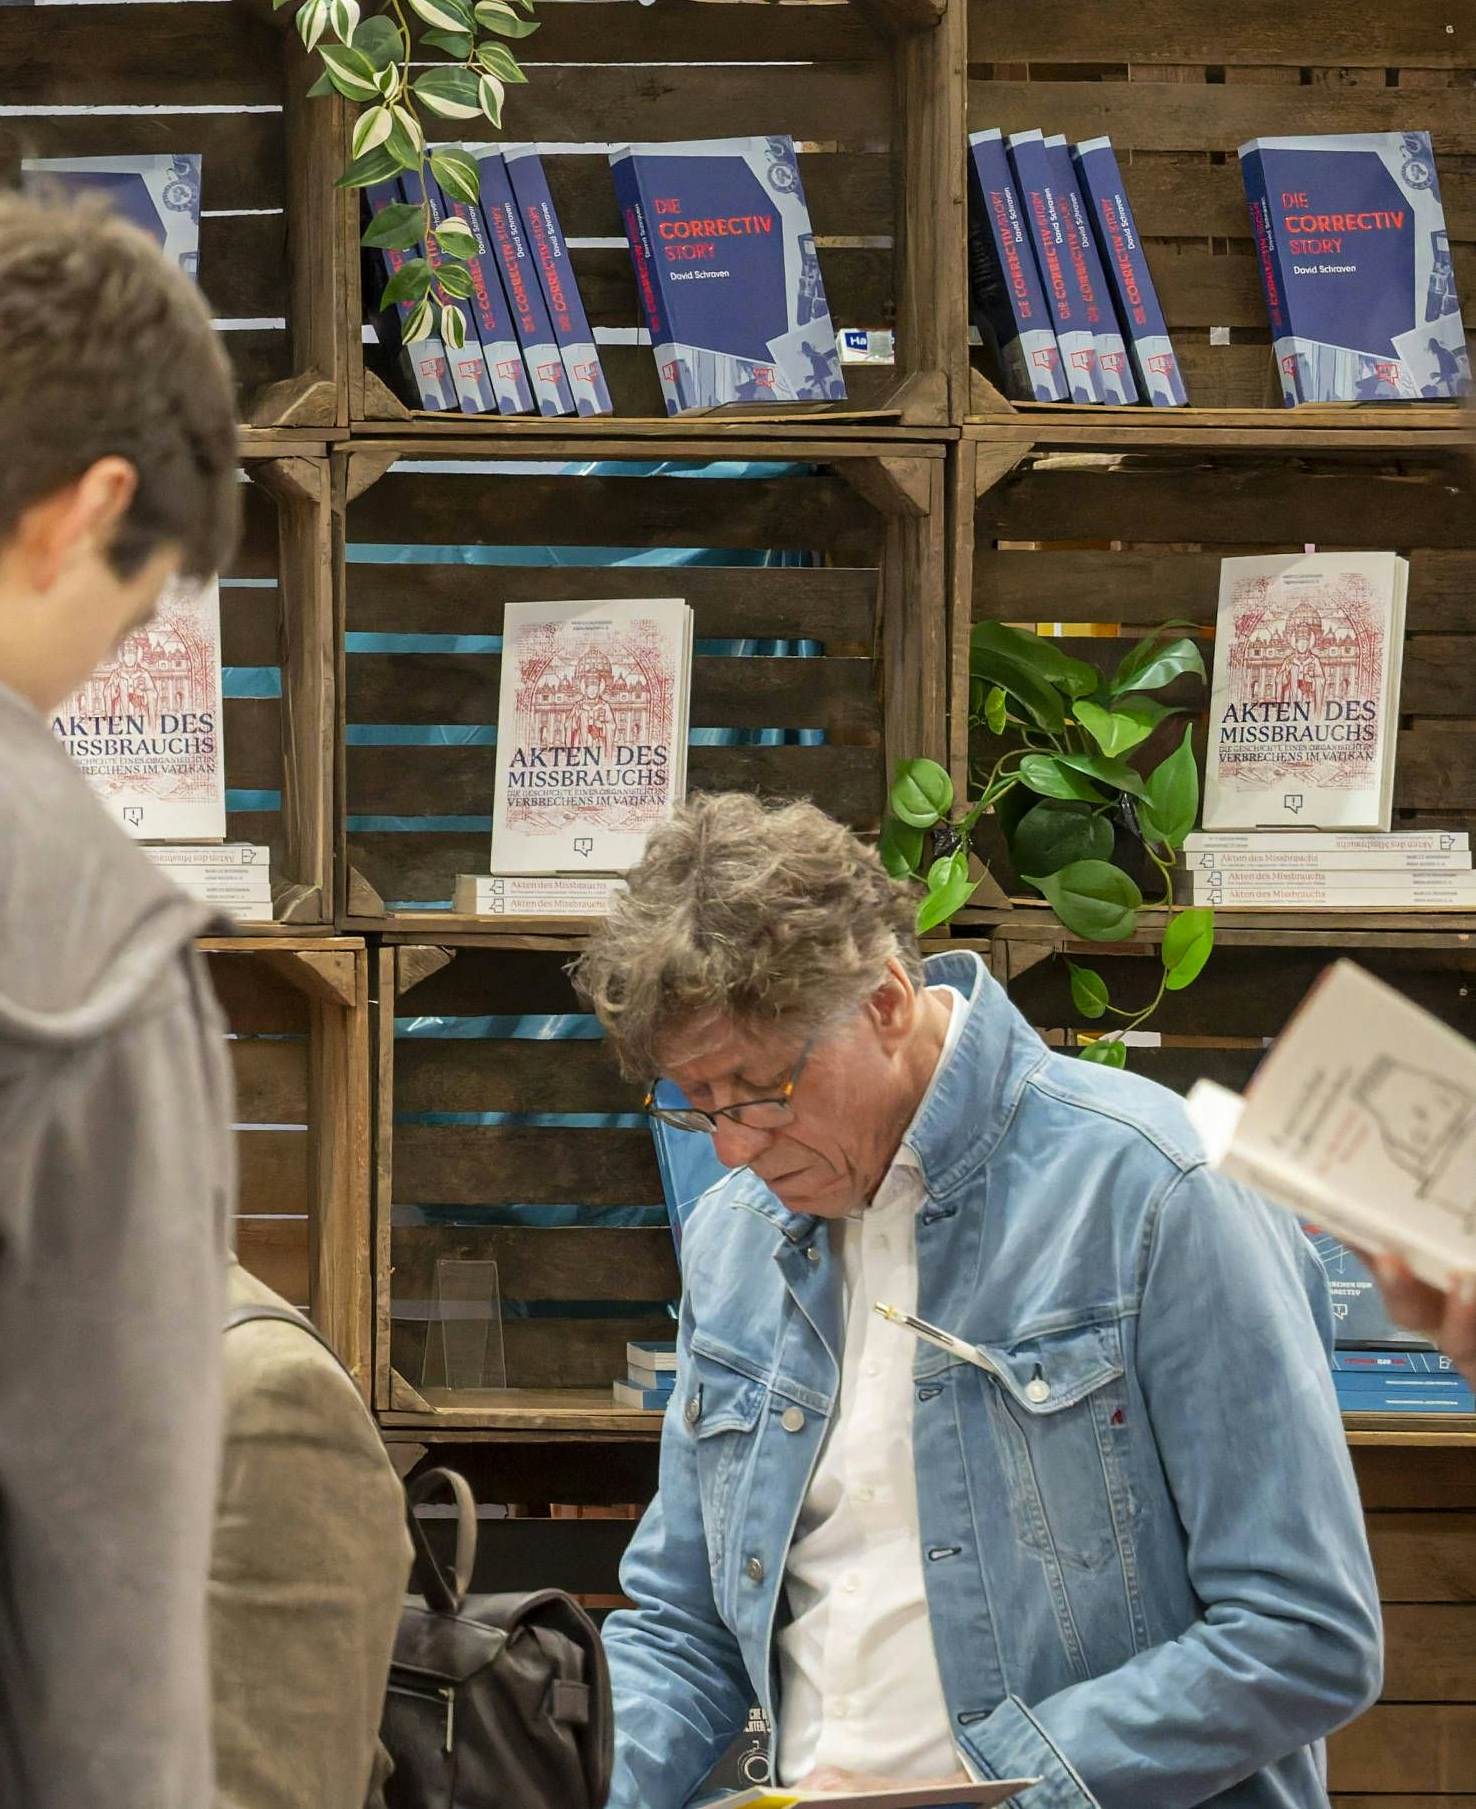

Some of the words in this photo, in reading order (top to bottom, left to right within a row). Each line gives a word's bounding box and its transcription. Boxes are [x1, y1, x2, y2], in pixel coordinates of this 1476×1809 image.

[654, 198, 680, 215] DIE
[1004, 186, 1018, 220] Schraven
[1281, 191, 1308, 208] DIE
[659, 217, 771, 240] CORRECTIV
[1012, 221, 1024, 243] David
[1285, 211, 1404, 234] CORRECTIV
[664, 244, 716, 262] STORY
[1290, 238, 1343, 254] STORY
[670, 270, 693, 281] David
[695, 269, 730, 278] Schraven
[1294, 266, 1318, 274] David
[1319, 264, 1356, 274] Schraven
[1222, 702, 1311, 723] AKTEN
[1325, 701, 1376, 721] DES
[51, 714, 144, 737] AKTEN
[160, 714, 214, 734] DES
[1220, 724, 1374, 743] MISSBRAUCHS
[69, 737, 214, 756] ISSBRAUCHS
[509, 746, 601, 768] AKTEN
[615, 745, 667, 766] DES
[508, 769, 666, 788] MISSBRAUCHS
[508, 797, 593, 807] VERBRECHENS
[596, 796, 610, 806] IM
[613, 795, 665, 806] VATIKAN
